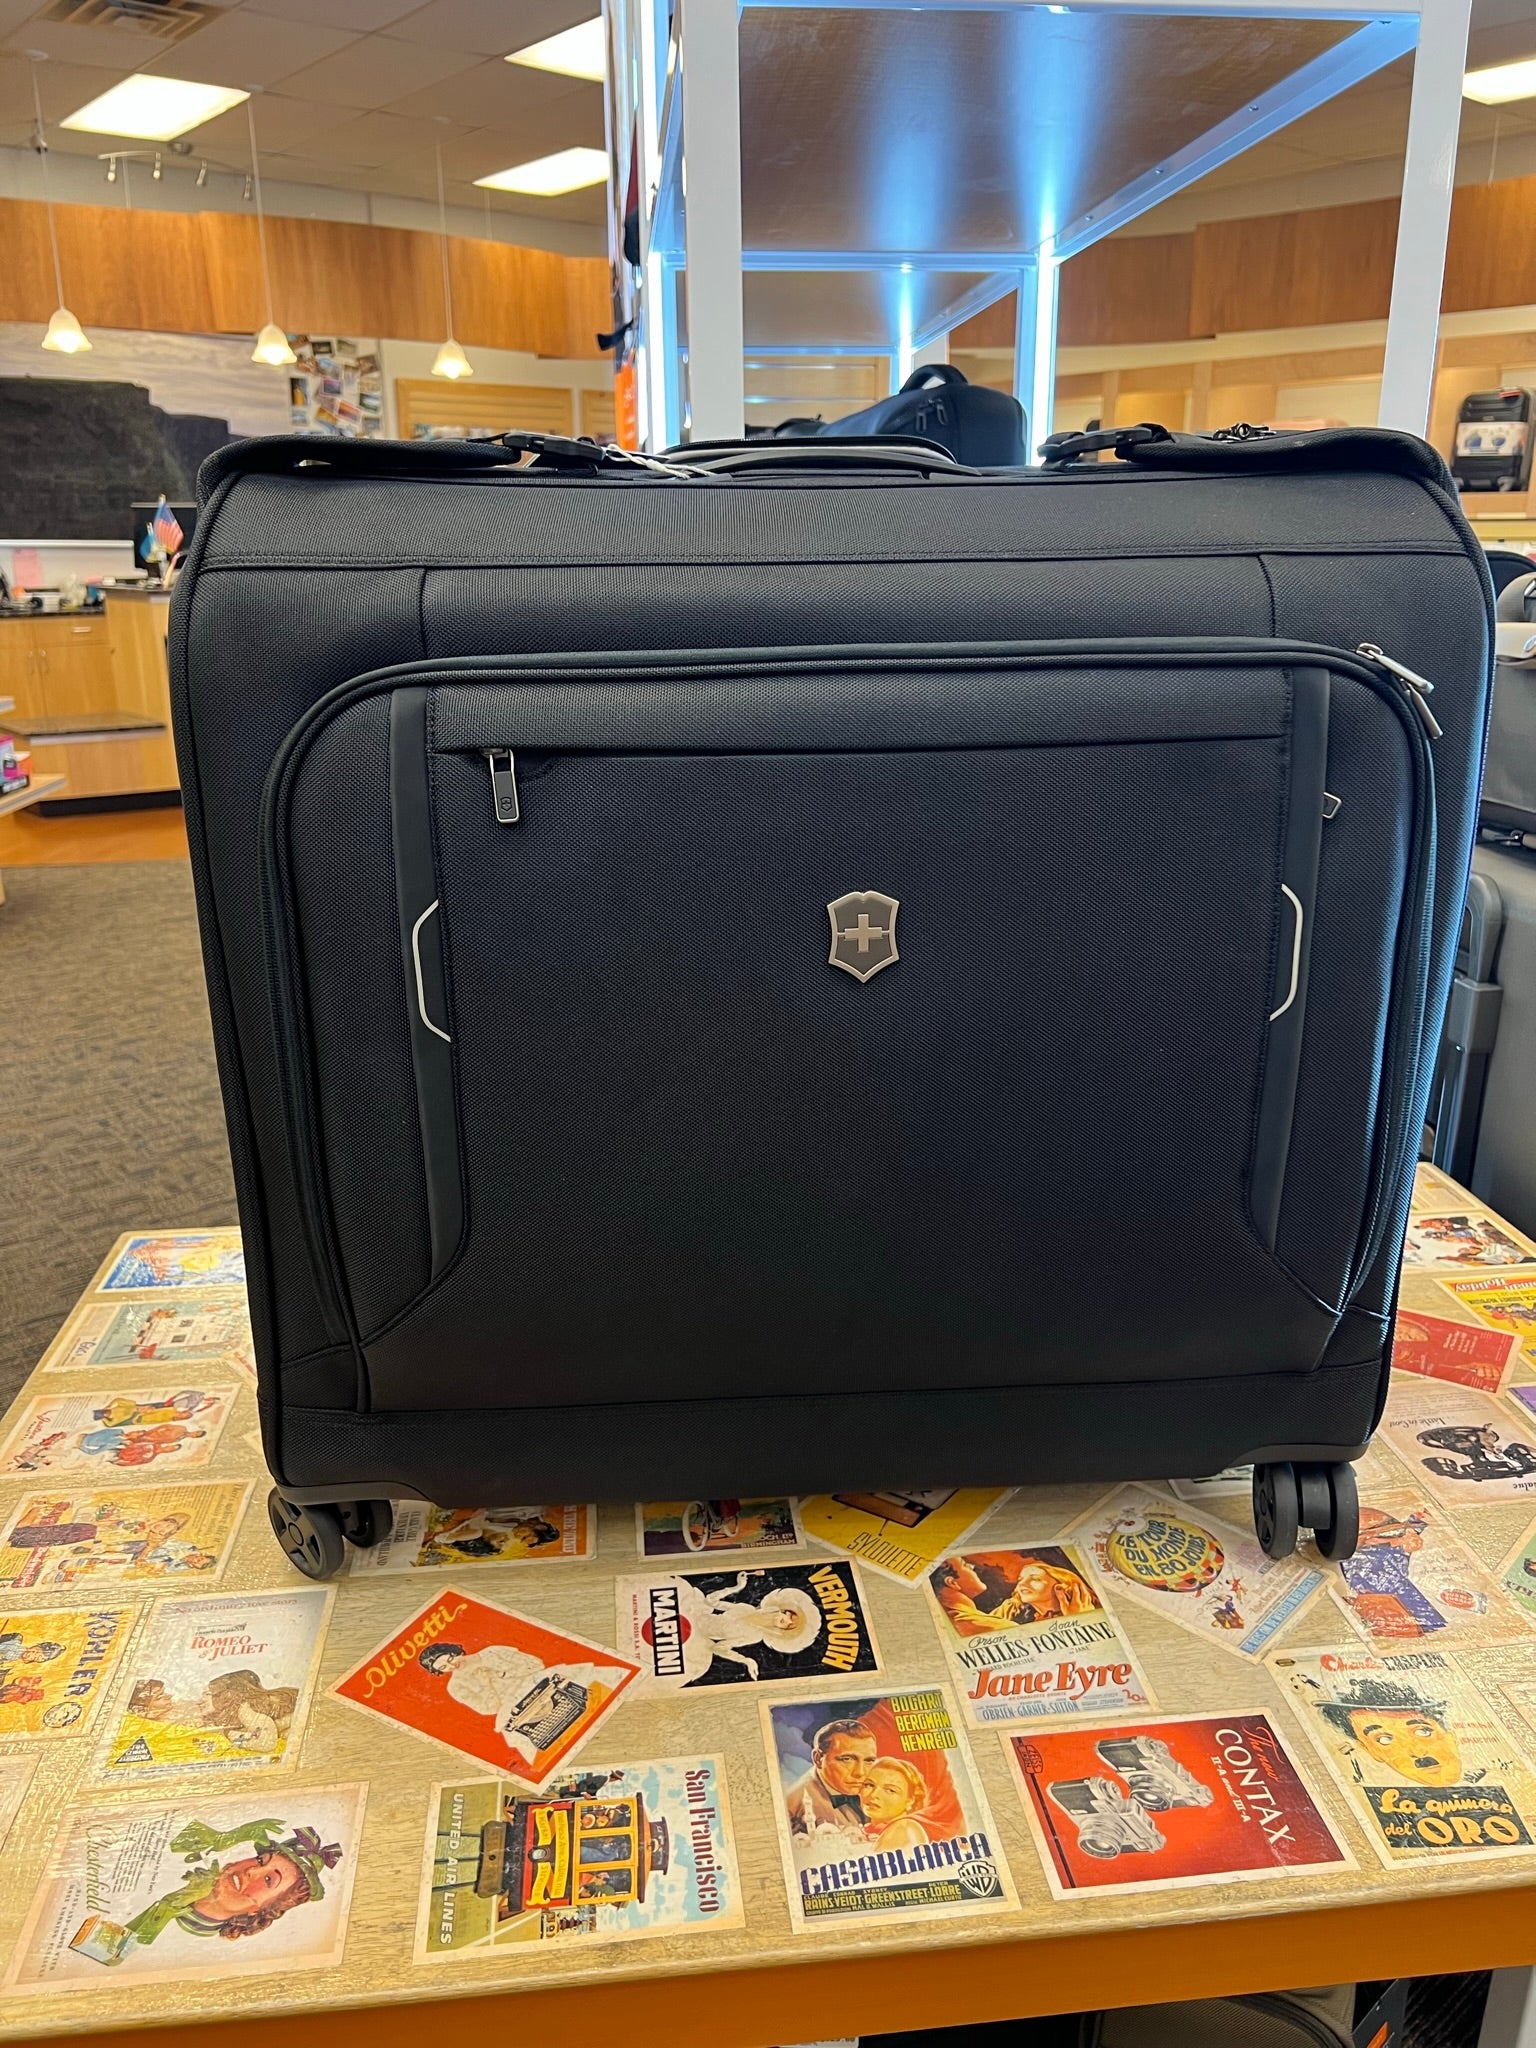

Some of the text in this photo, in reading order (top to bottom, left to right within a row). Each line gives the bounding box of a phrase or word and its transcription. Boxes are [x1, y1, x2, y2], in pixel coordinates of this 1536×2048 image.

[1455, 1277, 1506, 1292] Holiday
[1115, 1520, 1166, 1549] LE TOUR
[1124, 1526, 1186, 1563] DU MONDE
[846, 1531, 926, 1577] SYLOUETTE
[1133, 1534, 1207, 1577] EN 80 JOURS
[631, 1594, 639, 1616] MARTINI
[807, 1565, 860, 1671] VERMOUTH
[652, 1589, 681, 1675] MARTINI
[1048, 1618, 1081, 1632] Joan
[190, 1634, 252, 1650] ROMEO
[208, 1643, 268, 1661] JULIET
[363, 1603, 468, 1699] Olivetti
[956, 1621, 1117, 1669] WELLES FONTAINE
[968, 1633, 1008, 1649] Orson
[968, 1660, 1133, 1700] Jane Eyre
[890, 1692, 943, 1713] BOGART
[1049, 1701, 1080, 1715] SUTTON
[895, 1711, 952, 1733] BERGMAN
[900, 1731, 958, 1753] HENREID
[1241, 1726, 1284, 1765] The
[1027, 1743, 1044, 1772] ZEISS
[1215, 1728, 1296, 1846] CONTAX
[1380, 1788, 1514, 1817] La quimera
[684, 1768, 720, 1913] San Francisco
[1385, 1816, 1521, 1845] del ORO
[84, 1824, 111, 1916] Chesterfield
[440, 1793, 465, 1945] UNITED AIR LINES
[799, 1831, 993, 1896] CASABLANCA
[804, 1898, 834, 1911] RAINS
[834, 1895, 862, 1907] VEIDT
[864, 1887, 928, 1905] GREENSTREET
[929, 1884, 961, 1898] LORRE
